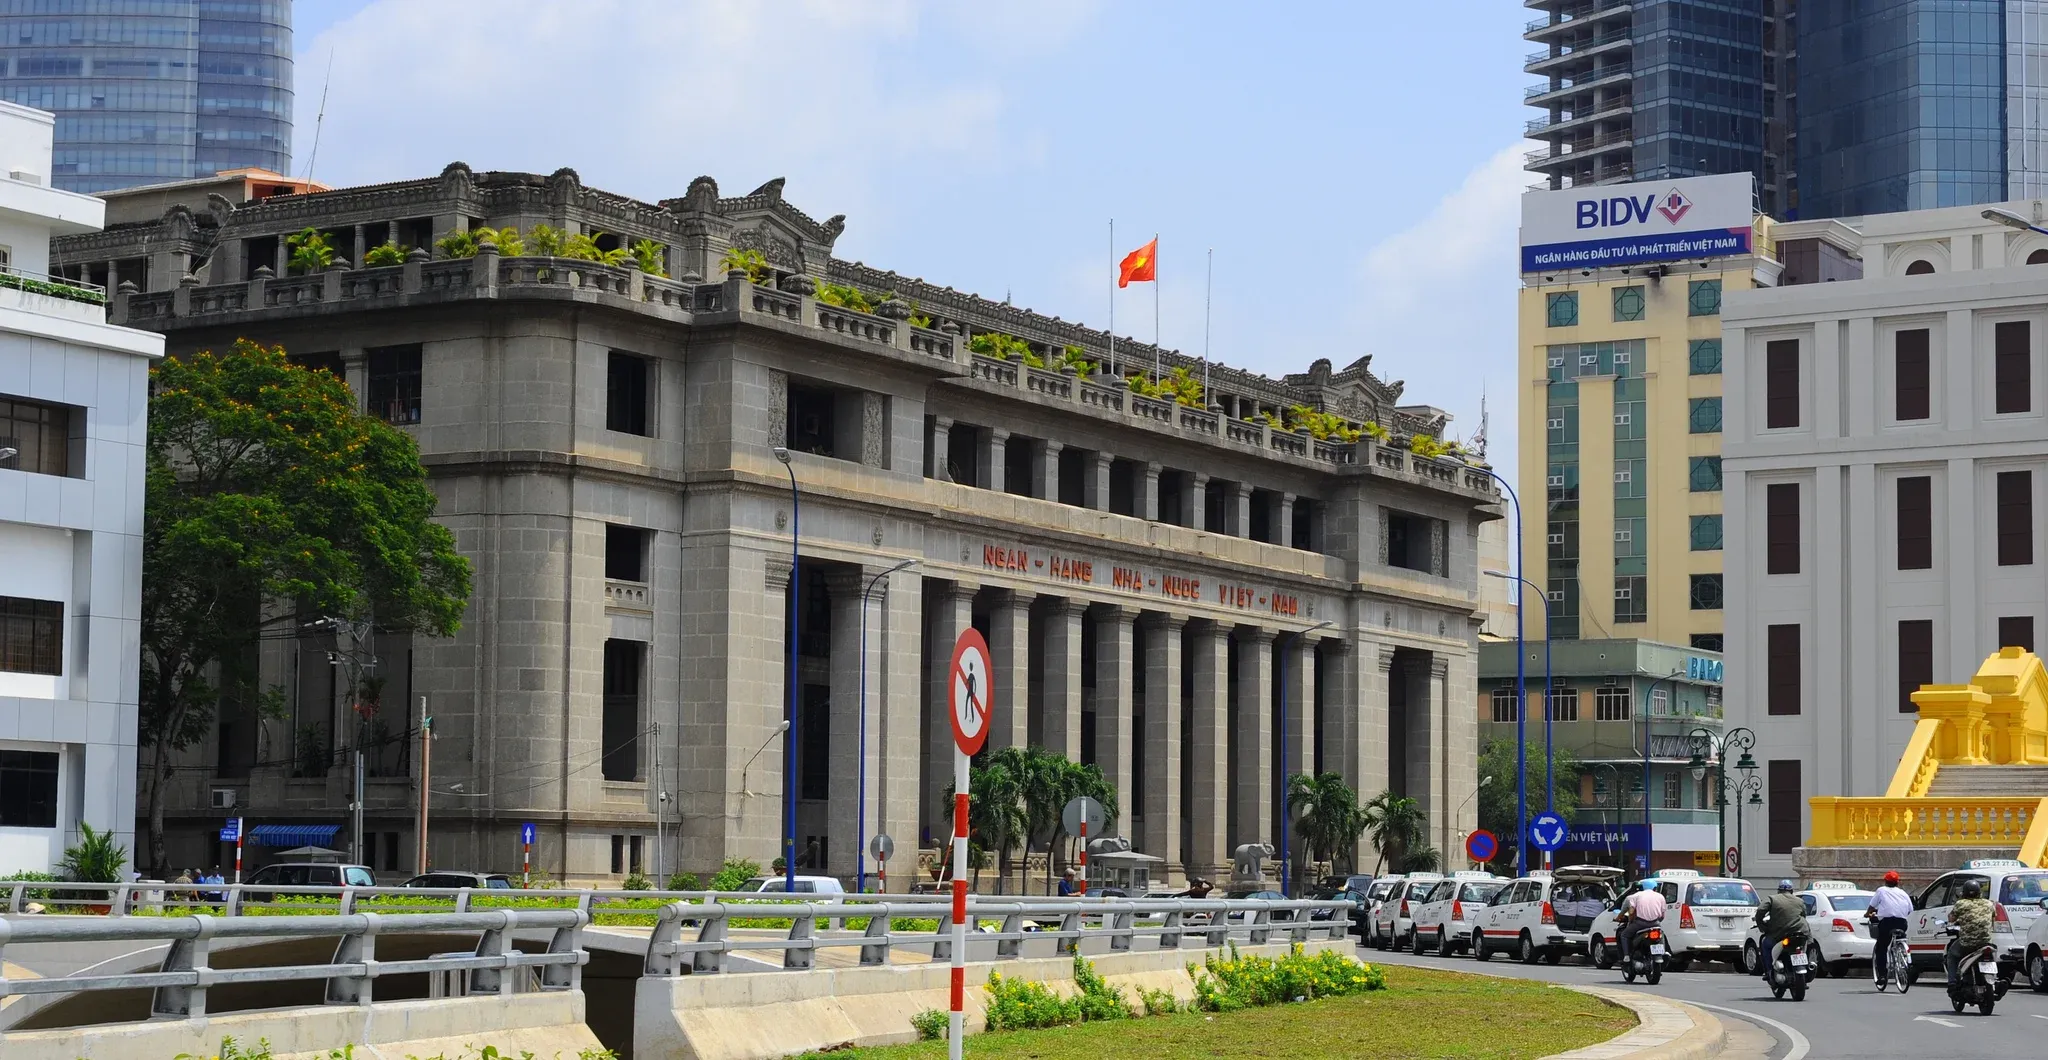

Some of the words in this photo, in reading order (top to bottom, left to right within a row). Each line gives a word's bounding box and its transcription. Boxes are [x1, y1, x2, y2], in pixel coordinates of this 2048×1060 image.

[1576, 194, 1656, 230] BIDV
[1535, 252, 1561, 264] NGÂN
[1563, 250, 1590, 262] HÀNG
[1611, 246, 1625, 257] TƯ
[1625, 244, 1638, 256] VÀ
[1639, 242, 1664, 255] PHÁT
[1664, 239, 1691, 253] TRIỂN
[1692, 238, 1713, 252] VIỆT
[1714, 237, 1737, 249] NAM
[983, 543, 1029, 573] NGAN
[1050, 555, 1093, 583] HANG
[1112, 566, 1143, 591] NHA
[1162, 574, 1201, 599] NUOC
[1218, 584, 1255, 608] VIET
[1271, 592, 1298, 616] NAM
[1579, 830, 1602, 845] VIỆT
